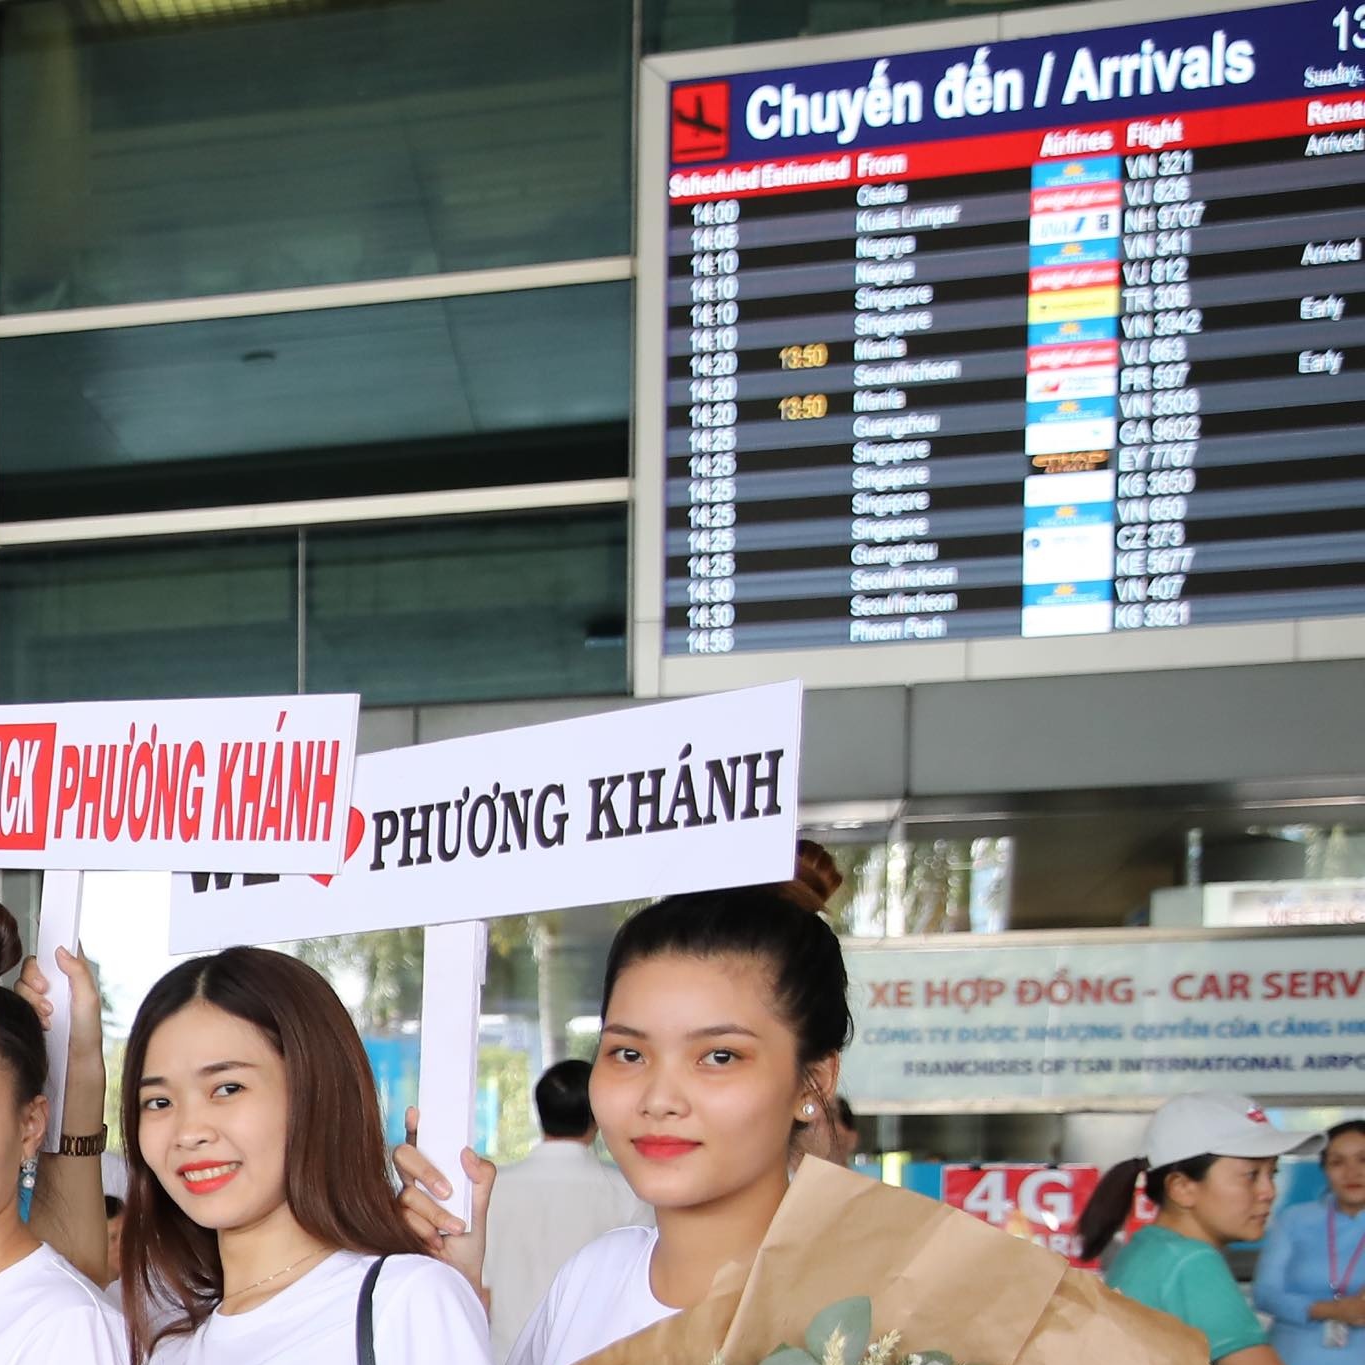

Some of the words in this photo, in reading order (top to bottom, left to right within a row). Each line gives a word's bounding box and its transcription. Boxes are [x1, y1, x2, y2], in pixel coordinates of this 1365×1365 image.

[746, 58, 923, 145] Chuyến
[934, 46, 1027, 122] đến
[1061, 30, 1255, 104] Arrivals
[669, 164, 760, 198] Scheduled
[760, 155, 851, 188] Estimated
[857, 152, 908, 177] From
[1039, 129, 1114, 157] Airlines
[1126, 119, 1184, 149] Flight
[691, 200, 739, 227] 14:00
[1125, 152, 1157, 180] VN
[691, 224, 739, 252] 14:05
[1124, 179, 1154, 206] VJ
[691, 250, 739, 277] 14:10
[1124, 205, 1156, 233] NH
[690, 275, 738, 302] 14:10
[1123, 233, 1156, 260] VN
[1300, 238, 1362, 266] Arrived
[690, 301, 738, 328] 14:10
[855, 285, 934, 312] Singapore
[1121, 260, 1151, 287] VJ
[690, 327, 738, 352] 14:10
[854, 311, 933, 338] Singapore
[1121, 286, 1153, 313] TR
[1299, 294, 1346, 321] Early
[690, 351, 738, 377] 14:20
[779, 342, 829, 370] 13:50
[1121, 313, 1154, 339] VN
[1121, 339, 1150, 366] VJ
[1298, 349, 1345, 376] Early
[689, 401, 738, 428] 14:20
[778, 394, 828, 421] 13:50
[1119, 392, 1152, 419] VN
[852, 439, 931, 466] Singapore
[1119, 419, 1152, 445] CA
[852, 465, 930, 492] Singapore
[1119, 445, 1150, 471] EY
[851, 517, 929, 543] Singapore
[1116, 498, 1149, 524] VN
[852, 491, 930, 517] Singapore
[1116, 524, 1147, 550] CZ
[1115, 576, 1148, 602] VN
[1116, 550, 1147, 577] KE
[53, 722, 206, 843] PHƯƠNG
[211, 711, 340, 842] KHÁNH
[371, 780, 568, 871] PHƯƠNG
[586, 743, 785, 842] KHÁNH
[869, 979, 912, 1009] XE
[925, 975, 1006, 1014] HỢP
[1016, 967, 1133, 1006] ĐỒNG
[1171, 973, 1252, 1003] CAR
[903, 1058, 1032, 1077] FRANCHISES
[1119, 1055, 1296, 1073] INTERNATIONAL
[963, 1170, 1074, 1226] 4G
